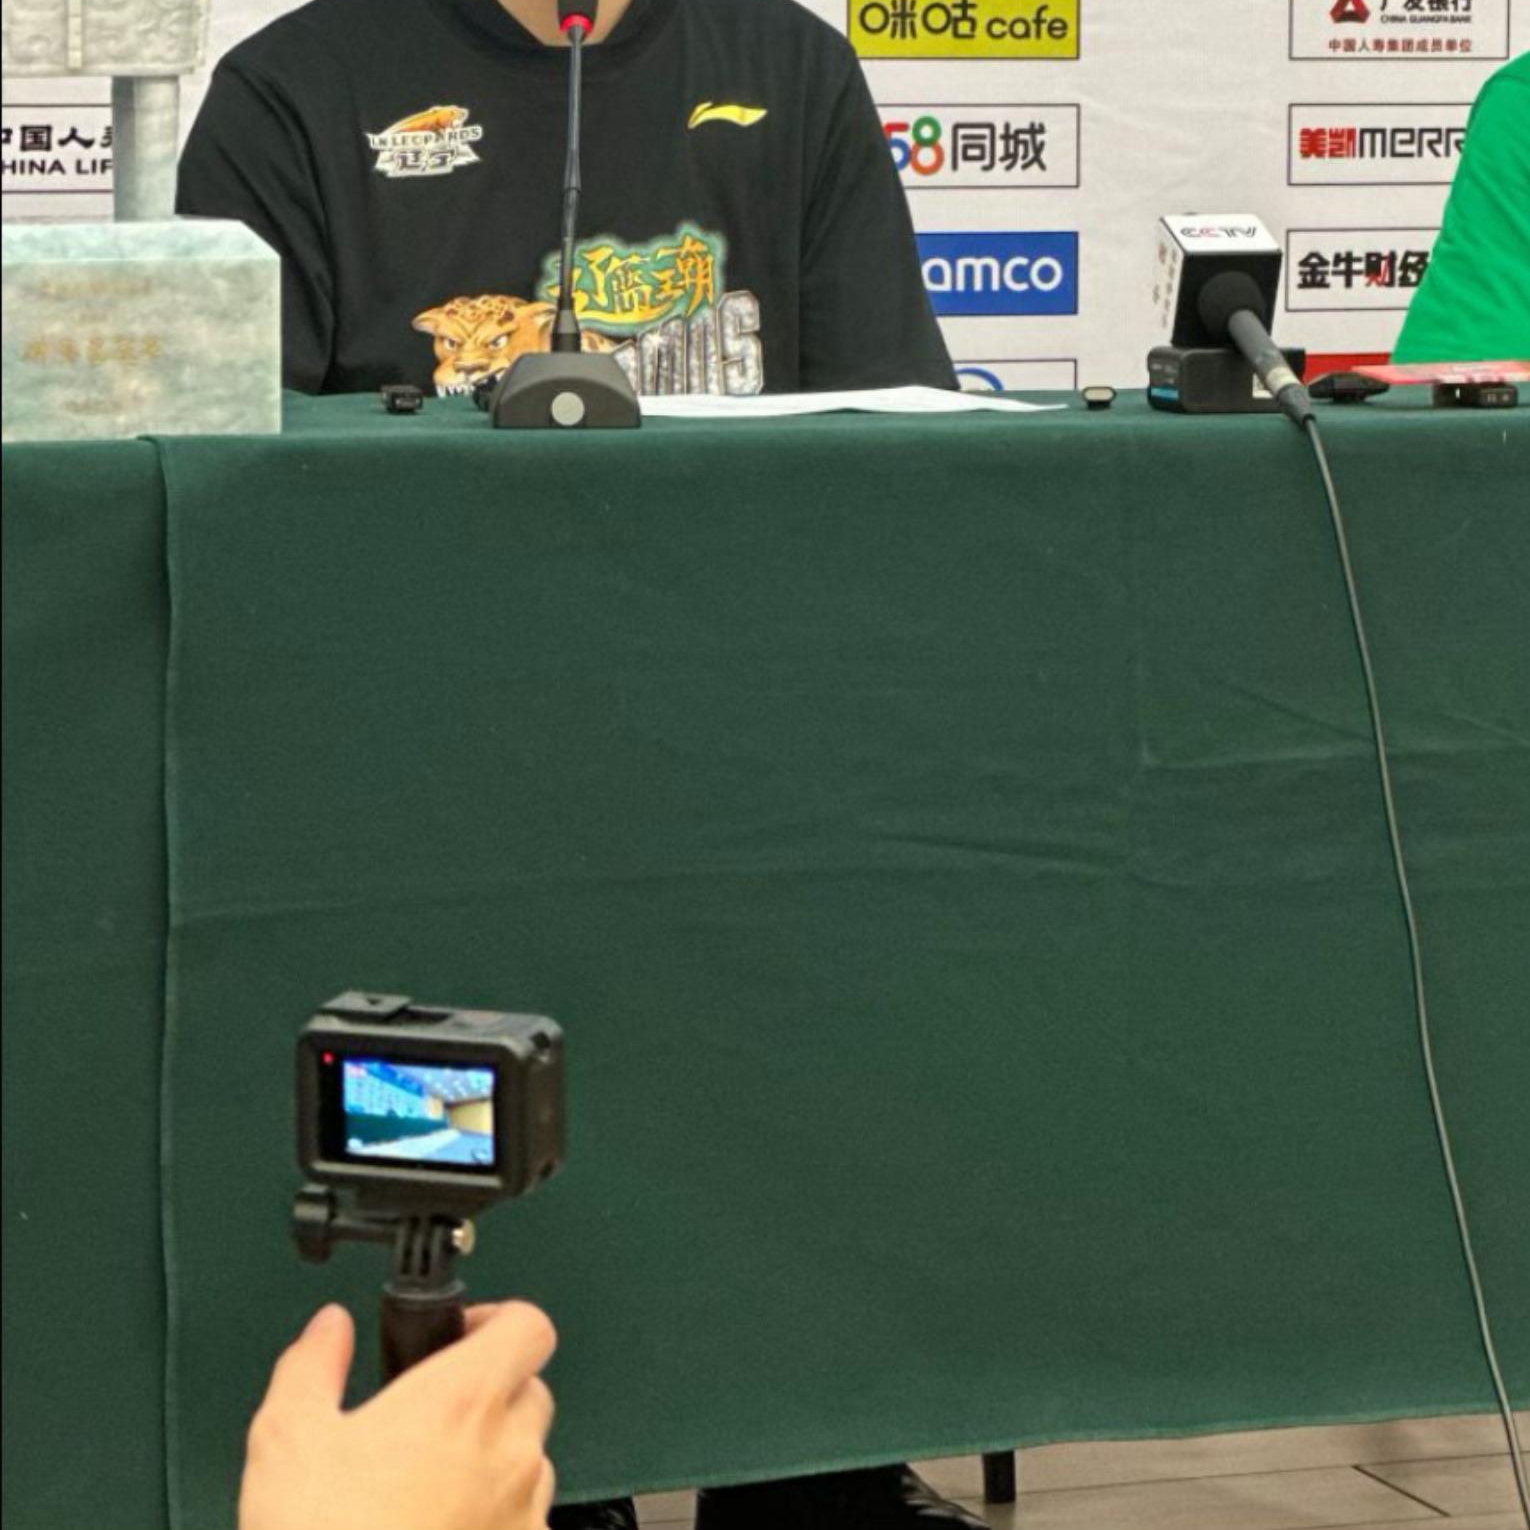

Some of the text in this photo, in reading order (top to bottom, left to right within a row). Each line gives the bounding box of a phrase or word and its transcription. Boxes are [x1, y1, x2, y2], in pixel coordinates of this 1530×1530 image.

[986, 5, 1068, 41] cafe
[884, 116, 1047, 176] 58同城
[1359, 128, 1466, 159] MERR
[2, 159, 113, 176] HINA LIF
[921, 256, 1063, 292] amco
